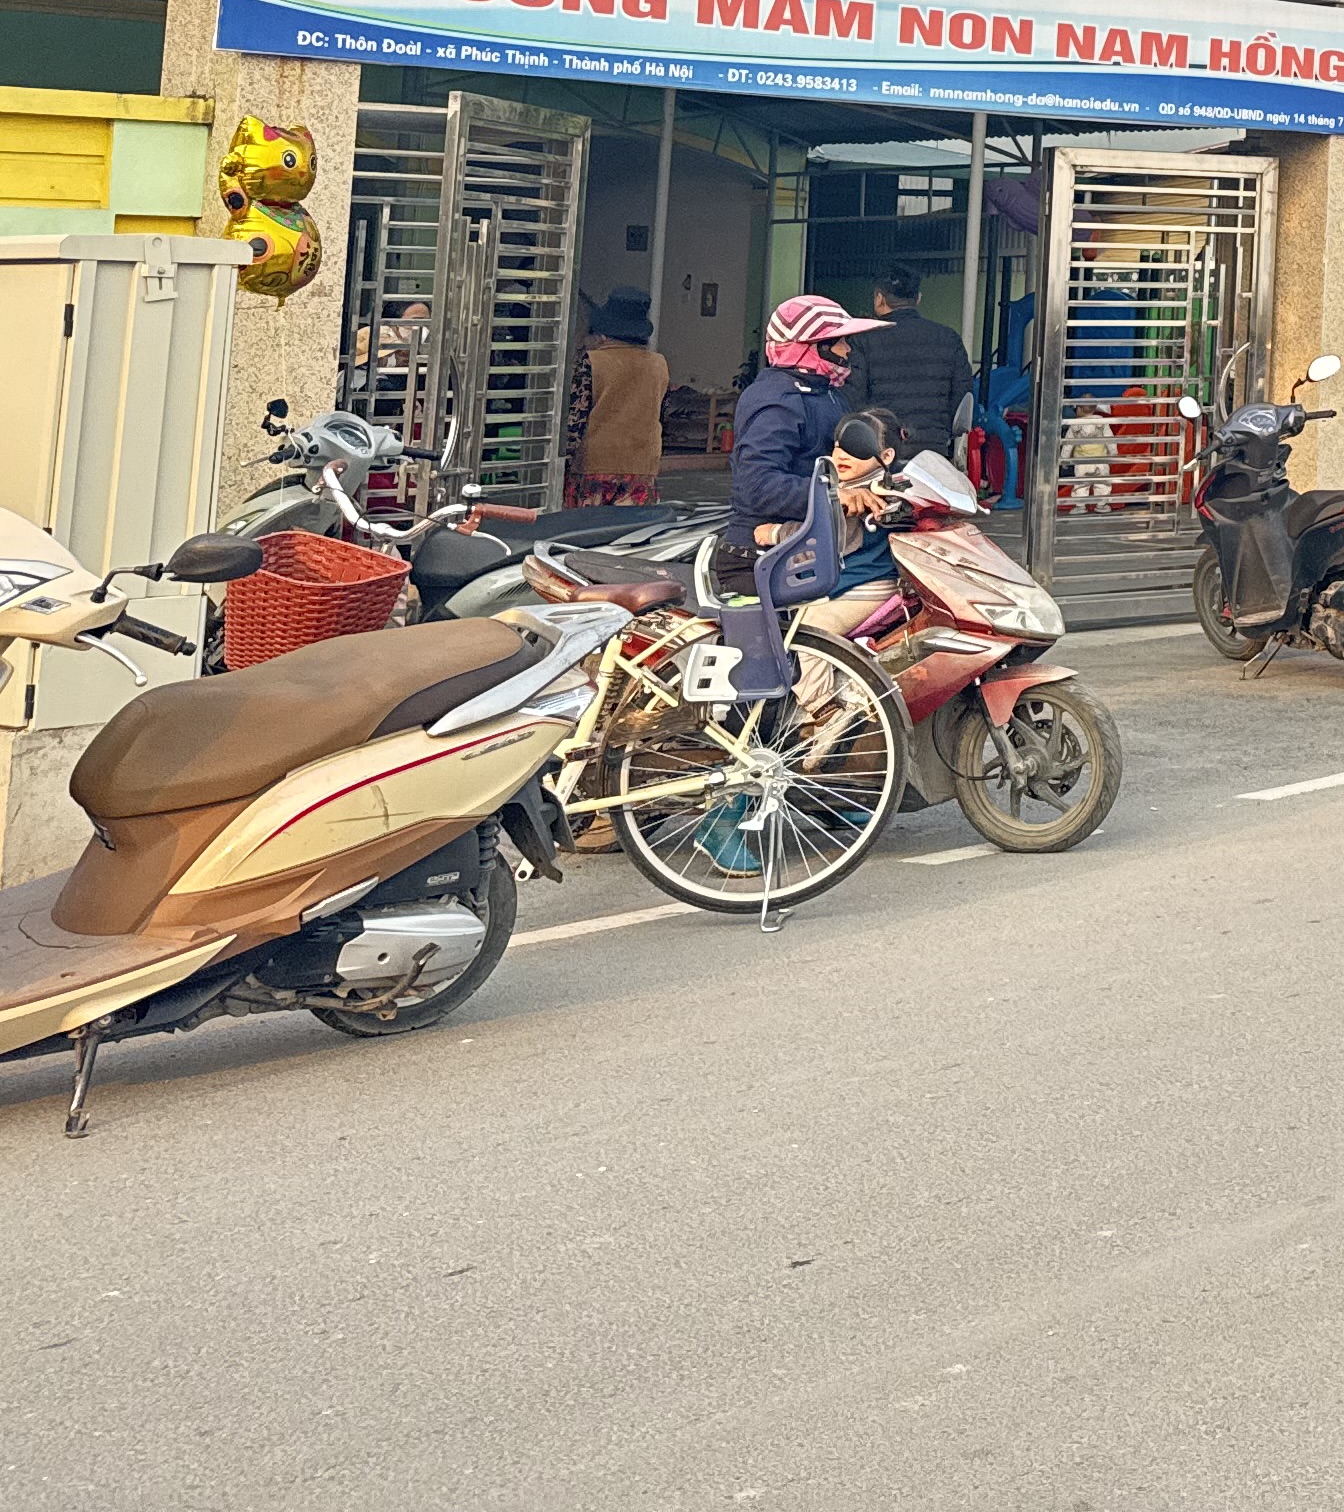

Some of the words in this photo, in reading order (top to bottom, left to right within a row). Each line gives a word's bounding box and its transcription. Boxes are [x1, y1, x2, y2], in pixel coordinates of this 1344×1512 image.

[899, 6, 1033, 55] NON
[1056, 22, 1189, 69] NAM
[296, 30, 329, 48] ĐC:
[334, 33, 377, 52] Thôn
[436, 44, 456, 59] xã
[461, 45, 501, 63] Phúc
[505, 49, 549, 69] Thịnh
[562, 54, 609, 72] Thành
[613, 58, 643, 76] phố
[645, 61, 665, 77] Hà
[668, 64, 694, 82] Nội
[727, 68, 752, 84] ĐT:
[756, 71, 857, 92] 0243.9583413
[882, 81, 923, 98] Email:
[1178, 102, 1193, 116] số
[1266, 111, 1291, 126] ngày
[1293, 112, 1306, 124] 14
[1307, 113, 1336, 129] tháng
[1338, 116, 1344, 127] 7
